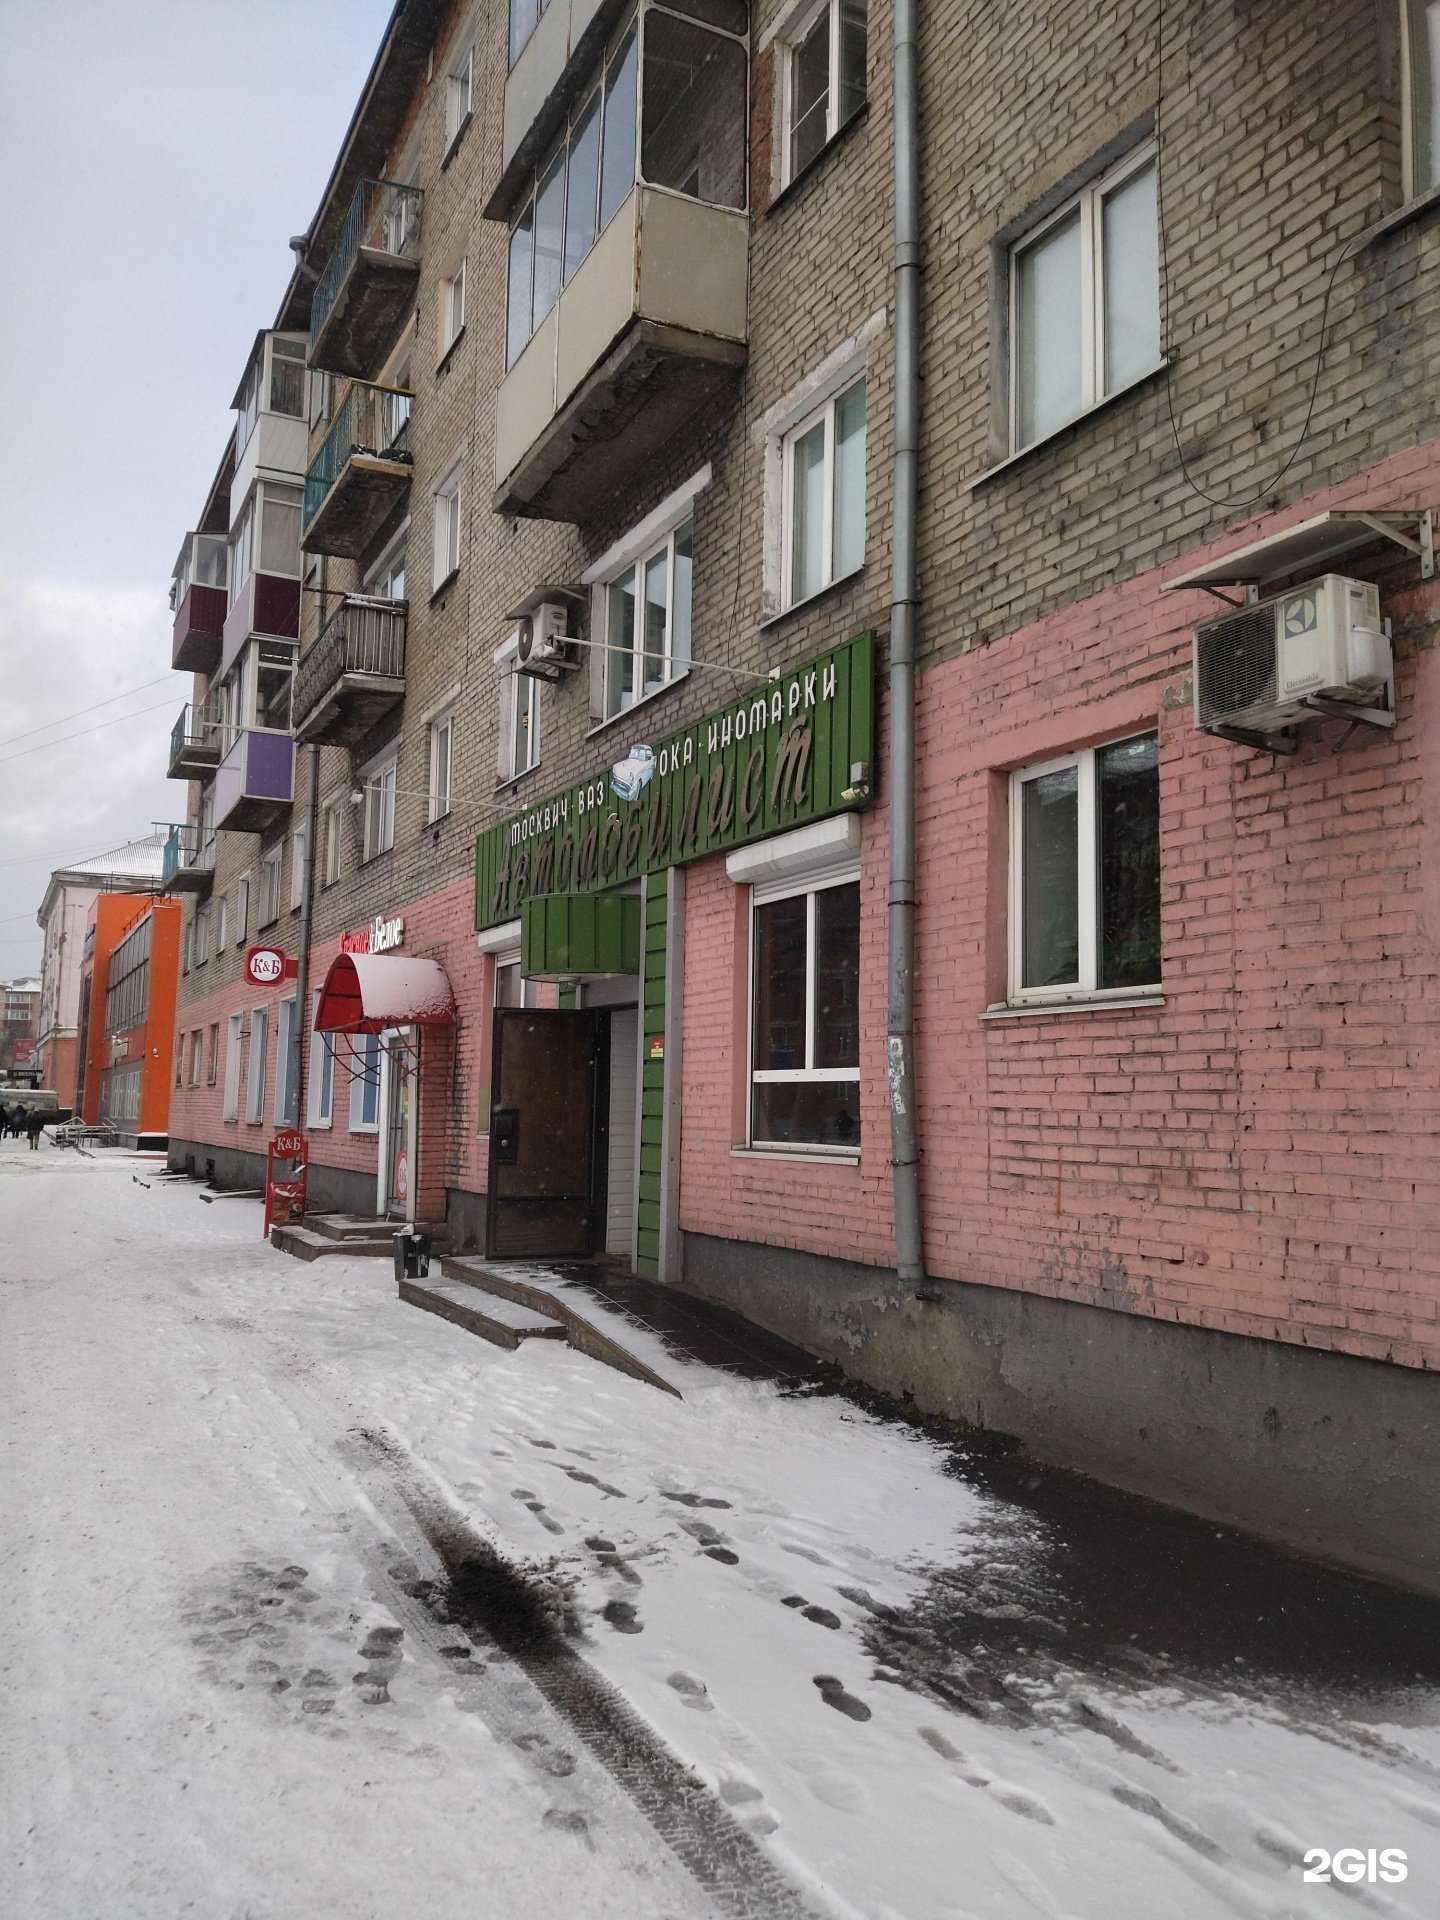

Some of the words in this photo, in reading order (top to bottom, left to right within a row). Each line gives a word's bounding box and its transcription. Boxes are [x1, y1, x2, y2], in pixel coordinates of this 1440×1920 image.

[511, 798, 568, 847] МОСКВИЧ
[578, 781, 604, 815] ВАЗ
[659, 737, 693, 777] ОКА
[708, 663, 835, 755] ИНОМАРКИ
[252, 958, 280, 975] К&Б
[276, 1136, 300, 1151] К&Б
